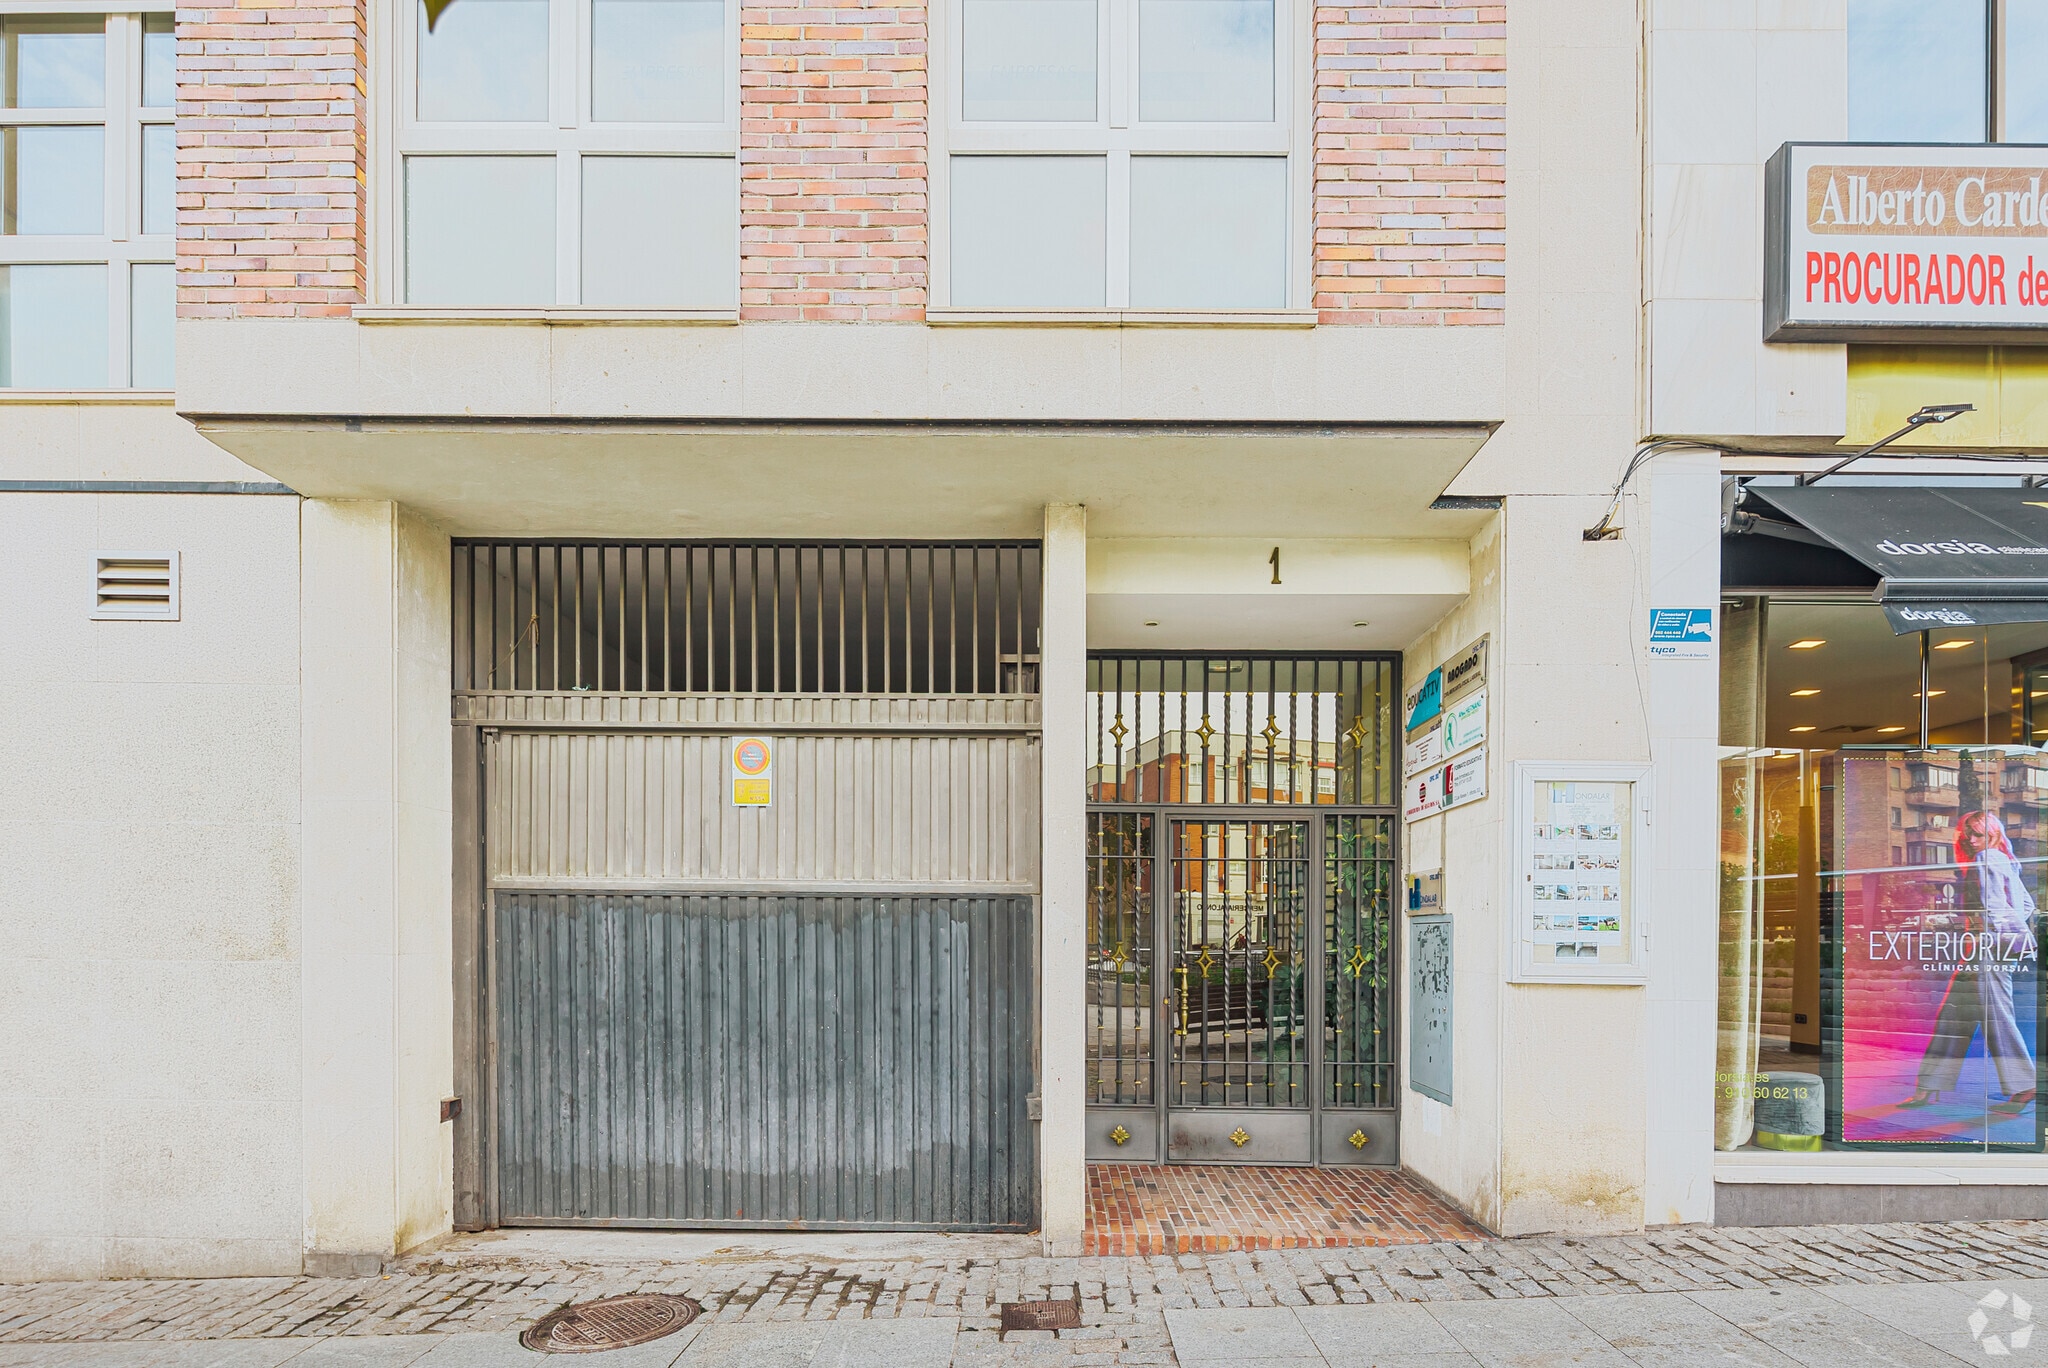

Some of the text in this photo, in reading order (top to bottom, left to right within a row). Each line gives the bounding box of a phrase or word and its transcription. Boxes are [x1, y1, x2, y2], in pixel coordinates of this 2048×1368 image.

[1815, 174, 1946, 227] Alberto
[1806, 251, 2048, 307] PROCURADOR de
[1876, 539, 2000, 556] dorsia
[1269, 546, 1282, 585] 1
[1900, 606, 1971, 622] dorsia
[1650, 646, 1676, 655] tyco
[1447, 653, 1478, 684] ABOGADO
[1869, 931, 2037, 962] EXTERIORIZA
[1923, 962, 2029, 973] CLÍNICAS DORSIA
[1725, 1087, 1748, 1099] 910
[1754, 1087, 1769, 1099] 60
[1773, 1087, 1789, 1099] 62
[1793, 1087, 1808, 1099] 13
